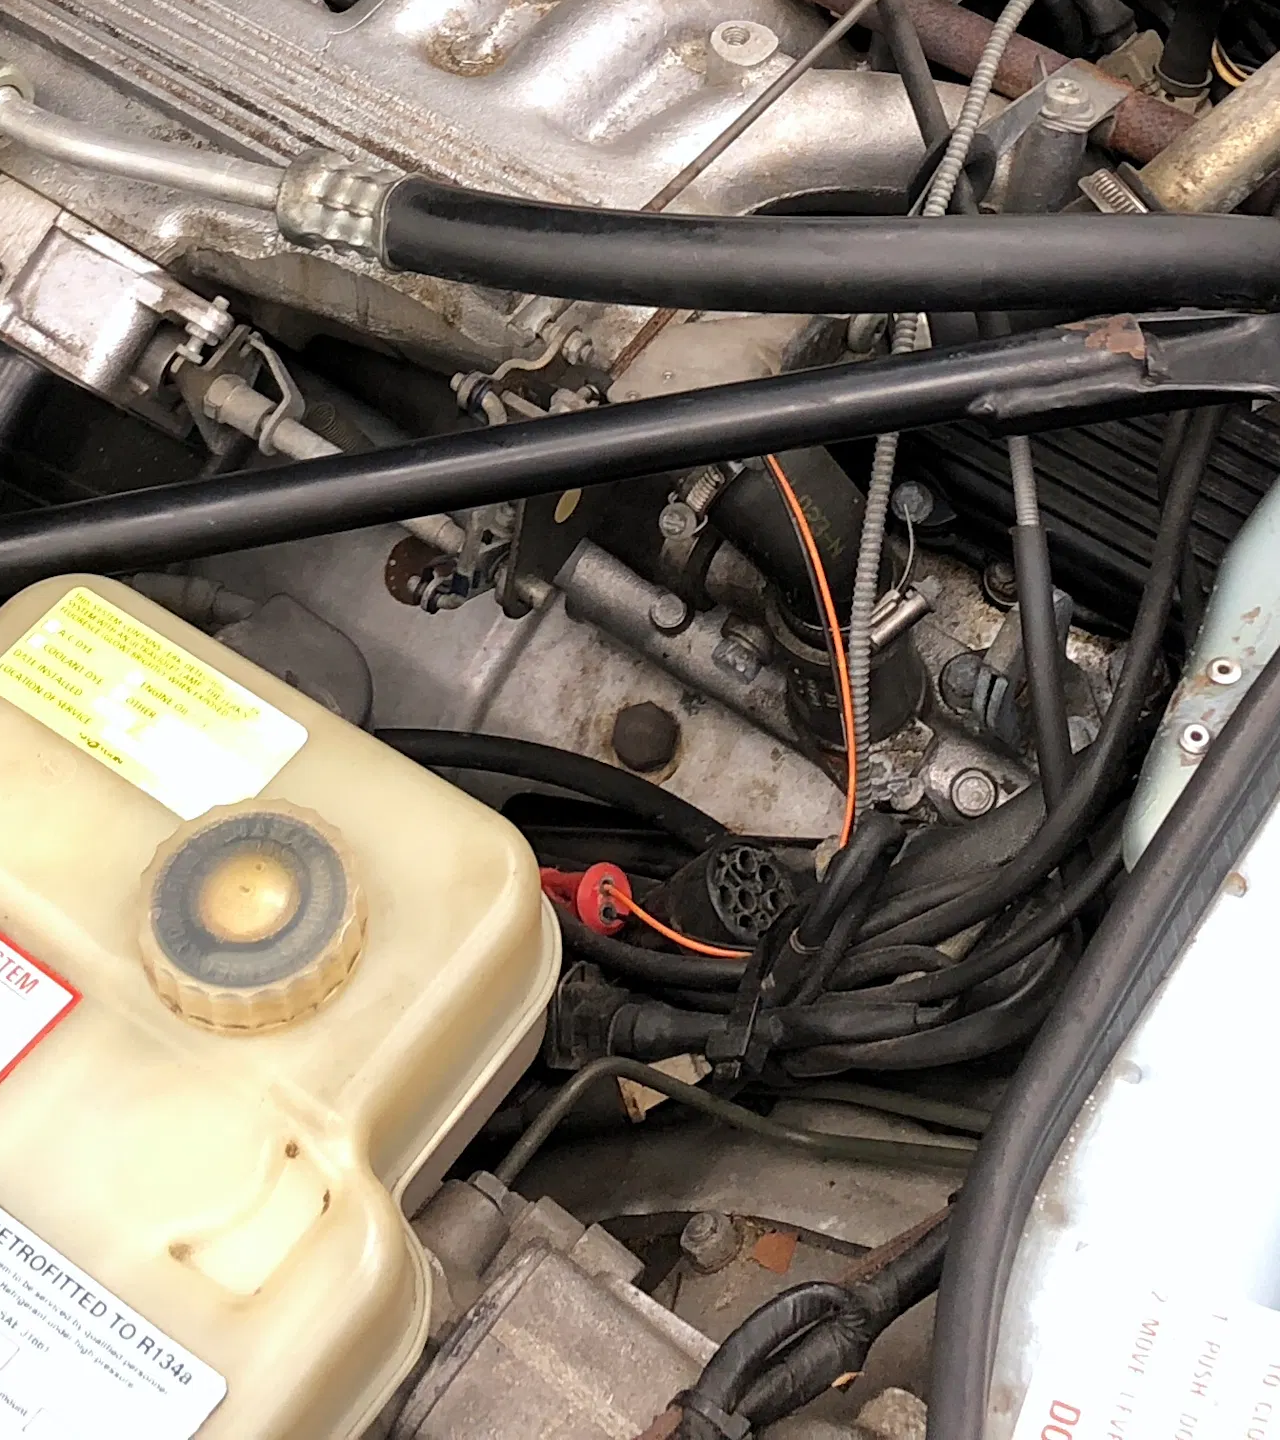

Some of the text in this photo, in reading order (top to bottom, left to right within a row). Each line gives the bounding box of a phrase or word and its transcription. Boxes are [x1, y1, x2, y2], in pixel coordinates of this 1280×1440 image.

[12, 645, 84, 699] DATE INSTALLED
[41, 641, 104, 686] COOLANT DYE
[167, 674, 192, 694] WHEN
[41, 688, 57, 704] OF
[54, 696, 92, 728] SERVICE
[124, 694, 157, 720] OTHER
[139, 679, 173, 705] ENGINE
[20, 1280, 34, 1293] be
[33, 1289, 73, 1322] serviced
[82, 1327, 124, 1362] qualified
[1125, 1316, 1160, 1378] MOVE
[71, 1338, 95, 1360] high
[92, 1355, 135, 1391] pressure
[104, 1311, 139, 1343] TO
[133, 1333, 196, 1388] R134a
[1188, 1338, 1221, 1399] PUSH
